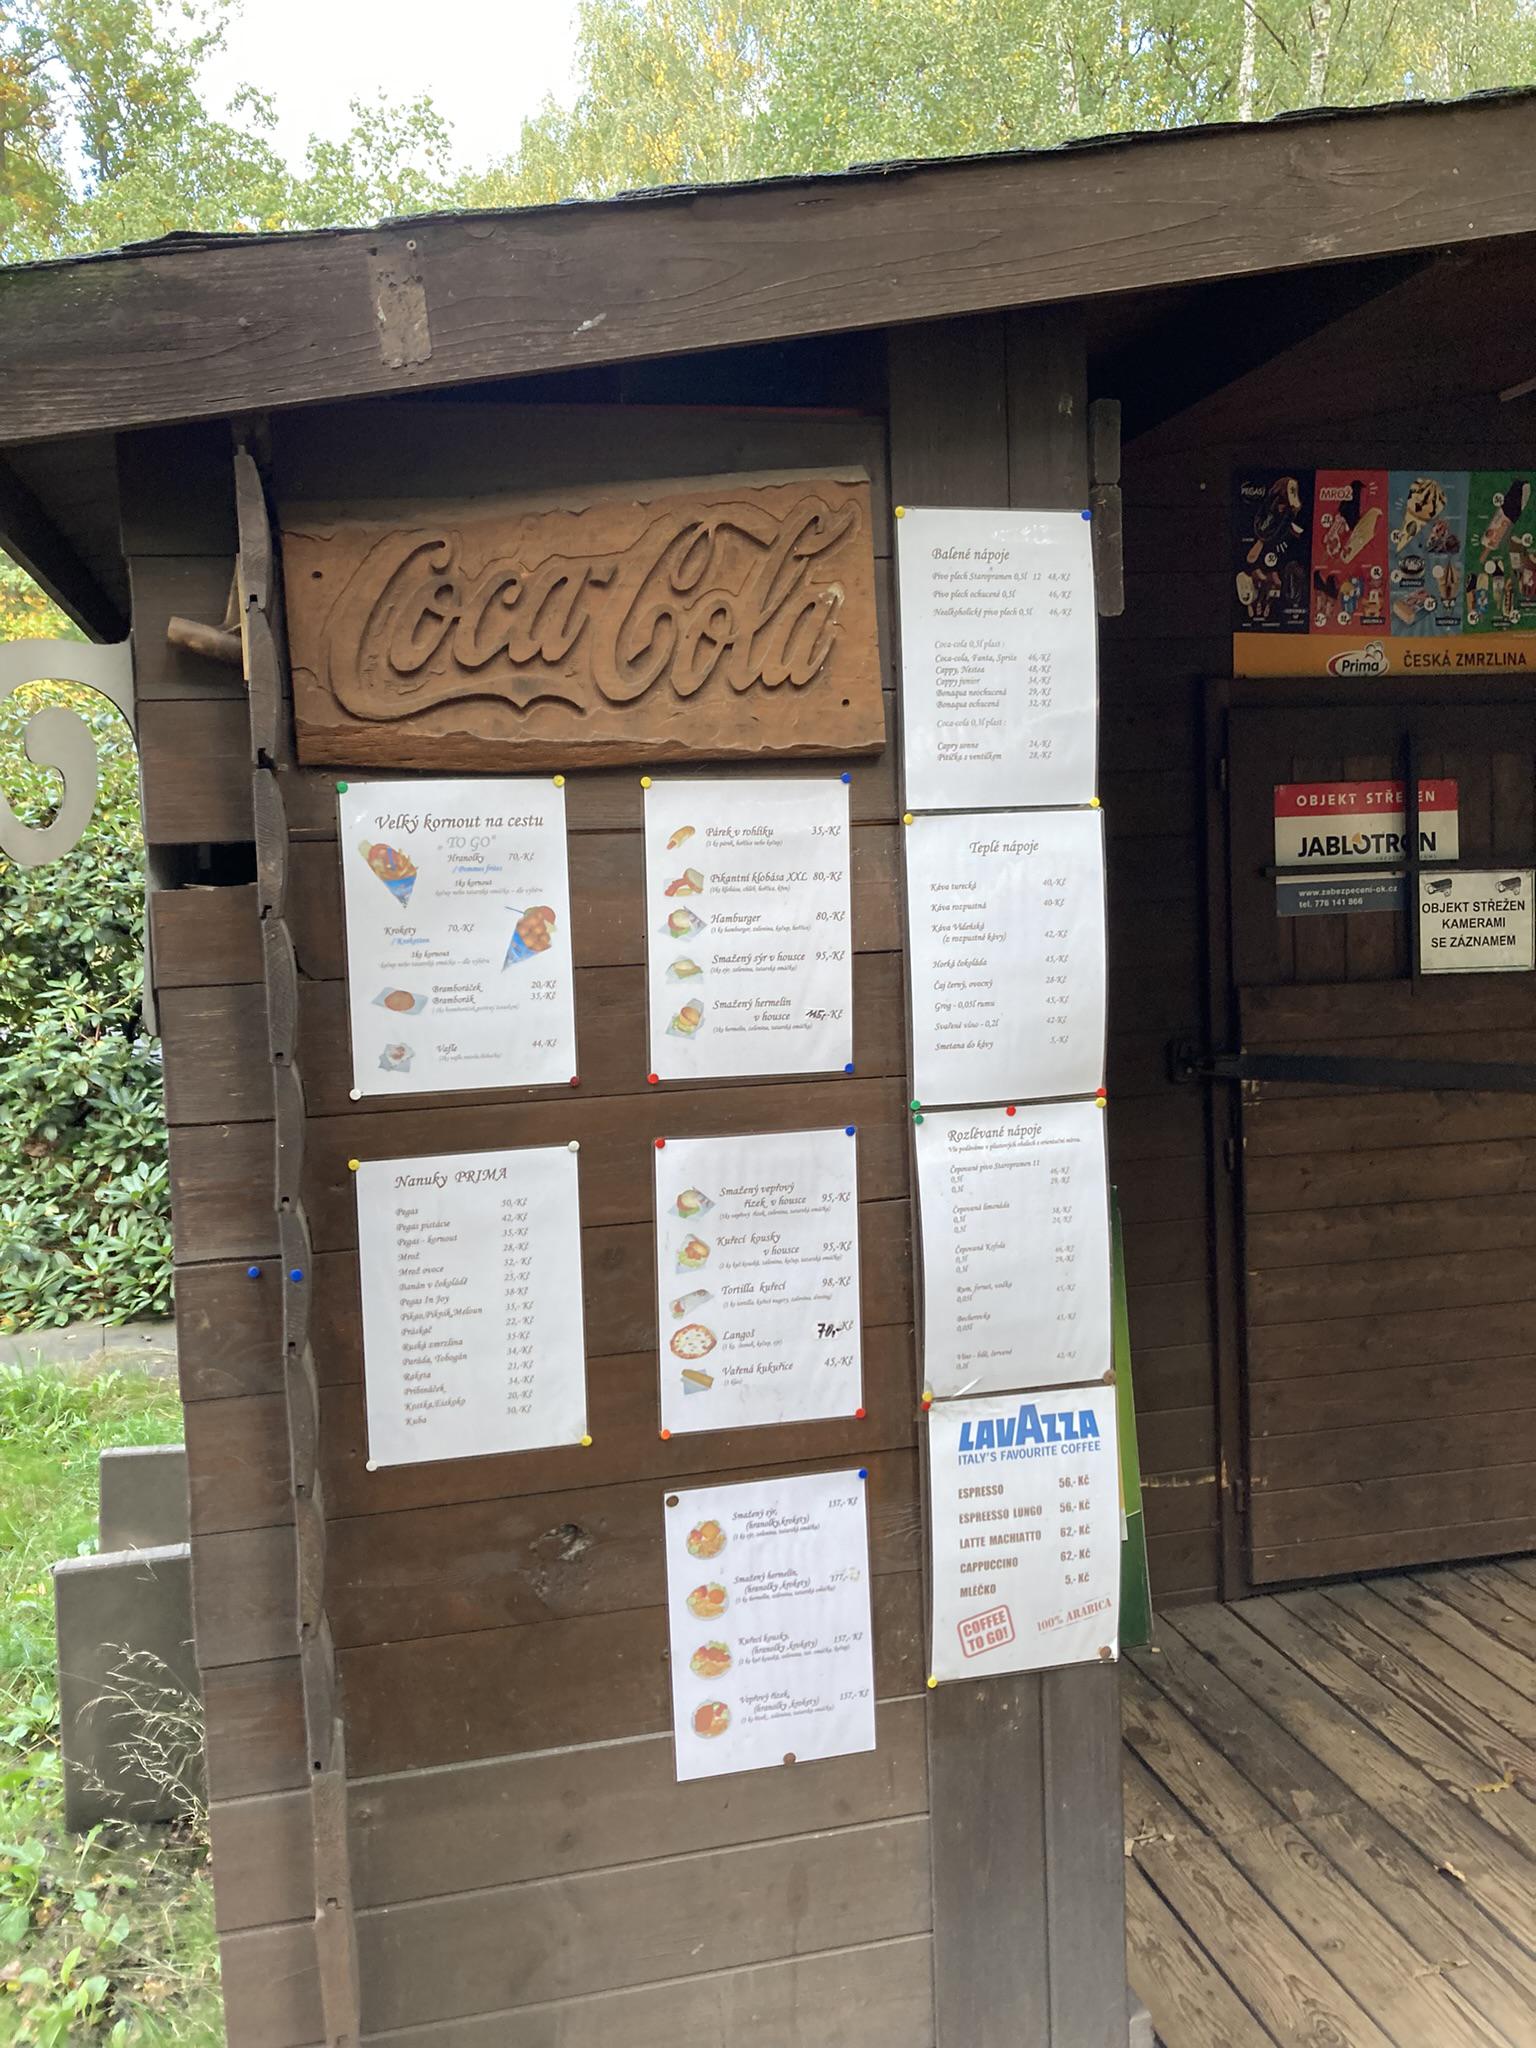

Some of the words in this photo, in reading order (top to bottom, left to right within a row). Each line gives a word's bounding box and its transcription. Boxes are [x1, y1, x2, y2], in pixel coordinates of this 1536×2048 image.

[1320, 486, 1352, 500] MROŽ
[932, 546, 971, 560] Balené
[974, 548, 1010, 564] nápoje
[1342, 658, 1379, 672] Prima
[1404, 651, 1451, 667] ČESKÁ
[1456, 652, 1526, 666] ZMRZLINA
[1297, 793, 1356, 806] OBJEKT
[1367, 790, 1435, 804] STŘEEN
[375, 813, 419, 834] Velký
[423, 813, 481, 832] kornout
[485, 817, 503, 827] na
[508, 815, 544, 827] cestu
[705, 826, 736, 839] Párek
[742, 826, 774, 837] rohlíku
[811, 825, 841, 837] 35,-Kč
[446, 836, 466, 849] TO
[969, 840, 1000, 857] Teplé
[1003, 840, 1039, 856] nápoje
[448, 853, 485, 864] Hranolky
[509, 852, 535, 862] 70,-Kč
[710, 872, 750, 885] Pikantní
[751, 872, 784, 884] klobása
[786, 871, 808, 882] XXL
[813, 871, 843, 882] 80,-Kč
[931, 883, 950, 892] Káva
[931, 904, 950, 913] Káva
[1422, 902, 1470, 913] OBJEKT
[1473, 898, 1525, 912] STŘEŽEN
[711, 913, 761, 925] Hamburger
[816, 911, 846, 922] 80,-Kč
[1442, 917, 1505, 928] KAMERAMI
[448, 924, 475, 933] 70,-Kč
[1431, 937, 1446, 948] SE
[1450, 935, 1516, 947] ZÁZNAMEM
[712, 954, 755, 966] Smažený
[753, 953, 767, 965] sýr
[777, 952, 805, 962] housce
[816, 950, 845, 962] 95,-Kč
[712, 999, 753, 1011] Smažený
[762, 1011, 791, 1021] housce
[947, 1126, 1004, 1143] Rozlévané
[1007, 1123, 1042, 1140] nápoje
[395, 1171, 448, 1189] Nanuky
[719, 1184, 759, 1197] Smažený
[761, 1182, 795, 1196] vepřový
[744, 1197, 768, 1209] řízek
[778, 1195, 807, 1206] housce
[822, 1192, 851, 1203] 95,-Kč
[716, 1234, 747, 1247] Kuřecí
[750, 1231, 781, 1245] kousky
[771, 1245, 800, 1255] housce
[823, 1240, 853, 1252] 95,-Kč
[721, 1283, 755, 1295] Tortilla
[759, 1281, 786, 1294] kuřecí
[822, 1276, 851, 1288] 98,-Kč
[722, 1329, 755, 1342] Langoš
[722, 1364, 754, 1376] Vařená
[756, 1361, 793, 1375] kukuřice
[824, 1355, 854, 1367] 45,-Kč
[958, 1404, 1100, 1452] LAVAZZA
[1000, 1445, 1057, 1461] FAVOURITE
[1061, 1440, 1101, 1455] COFFEE
[958, 1484, 1004, 1499] ESPRESSO
[1078, 1474, 1090, 1486] Kč
[1013, 1505, 1042, 1518] LUNGO
[1079, 1499, 1090, 1511] Kč
[960, 1536, 985, 1549] LATTE
[989, 1530, 1041, 1546] MACHIATTO
[1079, 1524, 1090, 1536] Kč
[960, 1557, 1018, 1574] CAPPUCCINO
[1079, 1548, 1090, 1559] Kč
[960, 1584, 996, 1598] MLÉČKO
[1078, 1572, 1090, 1583] Kč
[1037, 1615, 1063, 1631] 100%
[1066, 1598, 1112, 1622] ARABICA
[962, 1610, 1006, 1637] COFFEE
[968, 1637, 984, 1651] TO
[987, 1627, 1008, 1645] GO!
